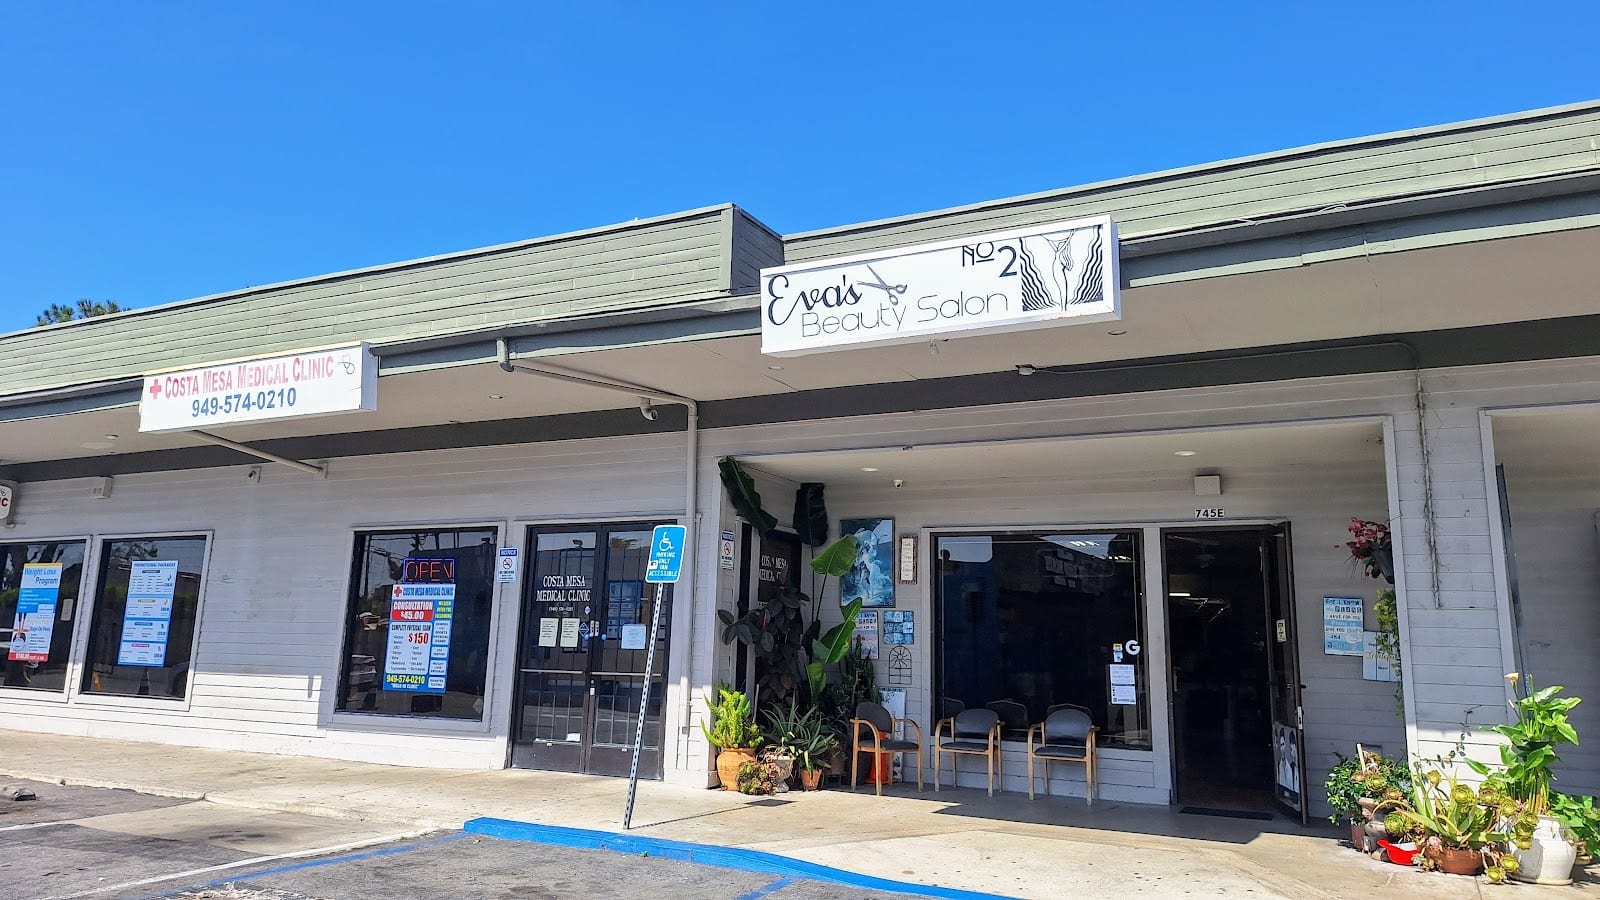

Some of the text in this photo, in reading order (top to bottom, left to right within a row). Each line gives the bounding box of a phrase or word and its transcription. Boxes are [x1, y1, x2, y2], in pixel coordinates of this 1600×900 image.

[998, 245, 1018, 278] 2
[767, 274, 862, 326] Eva's
[801, 291, 1009, 337] Beauty Salon
[192, 387, 297, 418] 949-574-0210
[1195, 508, 1224, 518] 745E
[24, 568, 43, 577] Weight
[406, 561, 453, 582] OPEN
[35, 577, 58, 586] Program
[543, 575, 586, 587] COSTA MESA
[536, 590, 591, 602] MEDICAL CLINIC
[393, 601, 434, 610] CONSULTATION
[401, 610, 424, 620] $45.00
[408, 632, 429, 644] $150
[1125, 640, 1140, 655] G
[386, 674, 426, 684] 949-574-0210
